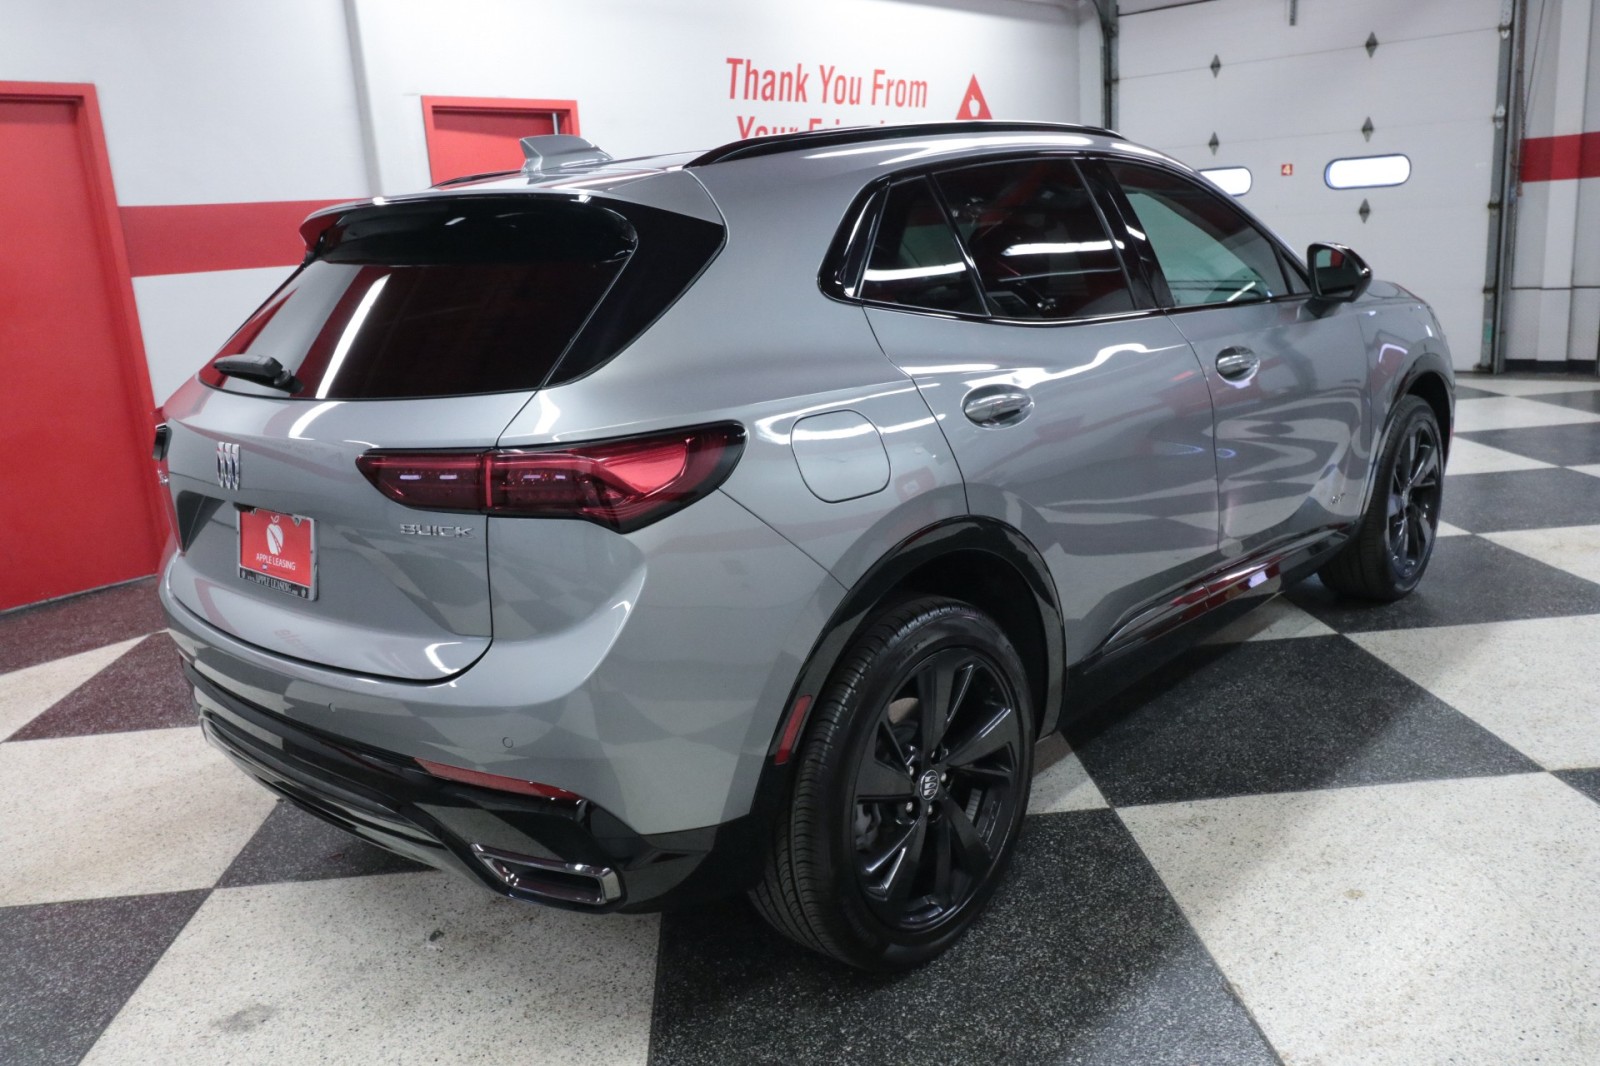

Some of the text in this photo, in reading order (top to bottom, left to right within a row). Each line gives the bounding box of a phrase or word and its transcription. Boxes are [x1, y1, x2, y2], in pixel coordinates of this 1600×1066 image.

[726, 57, 928, 108] Thank You From
[400, 523, 475, 538] BUICK
[256, 553, 272, 564] APPLE
[273, 558, 295, 570] LEASING
